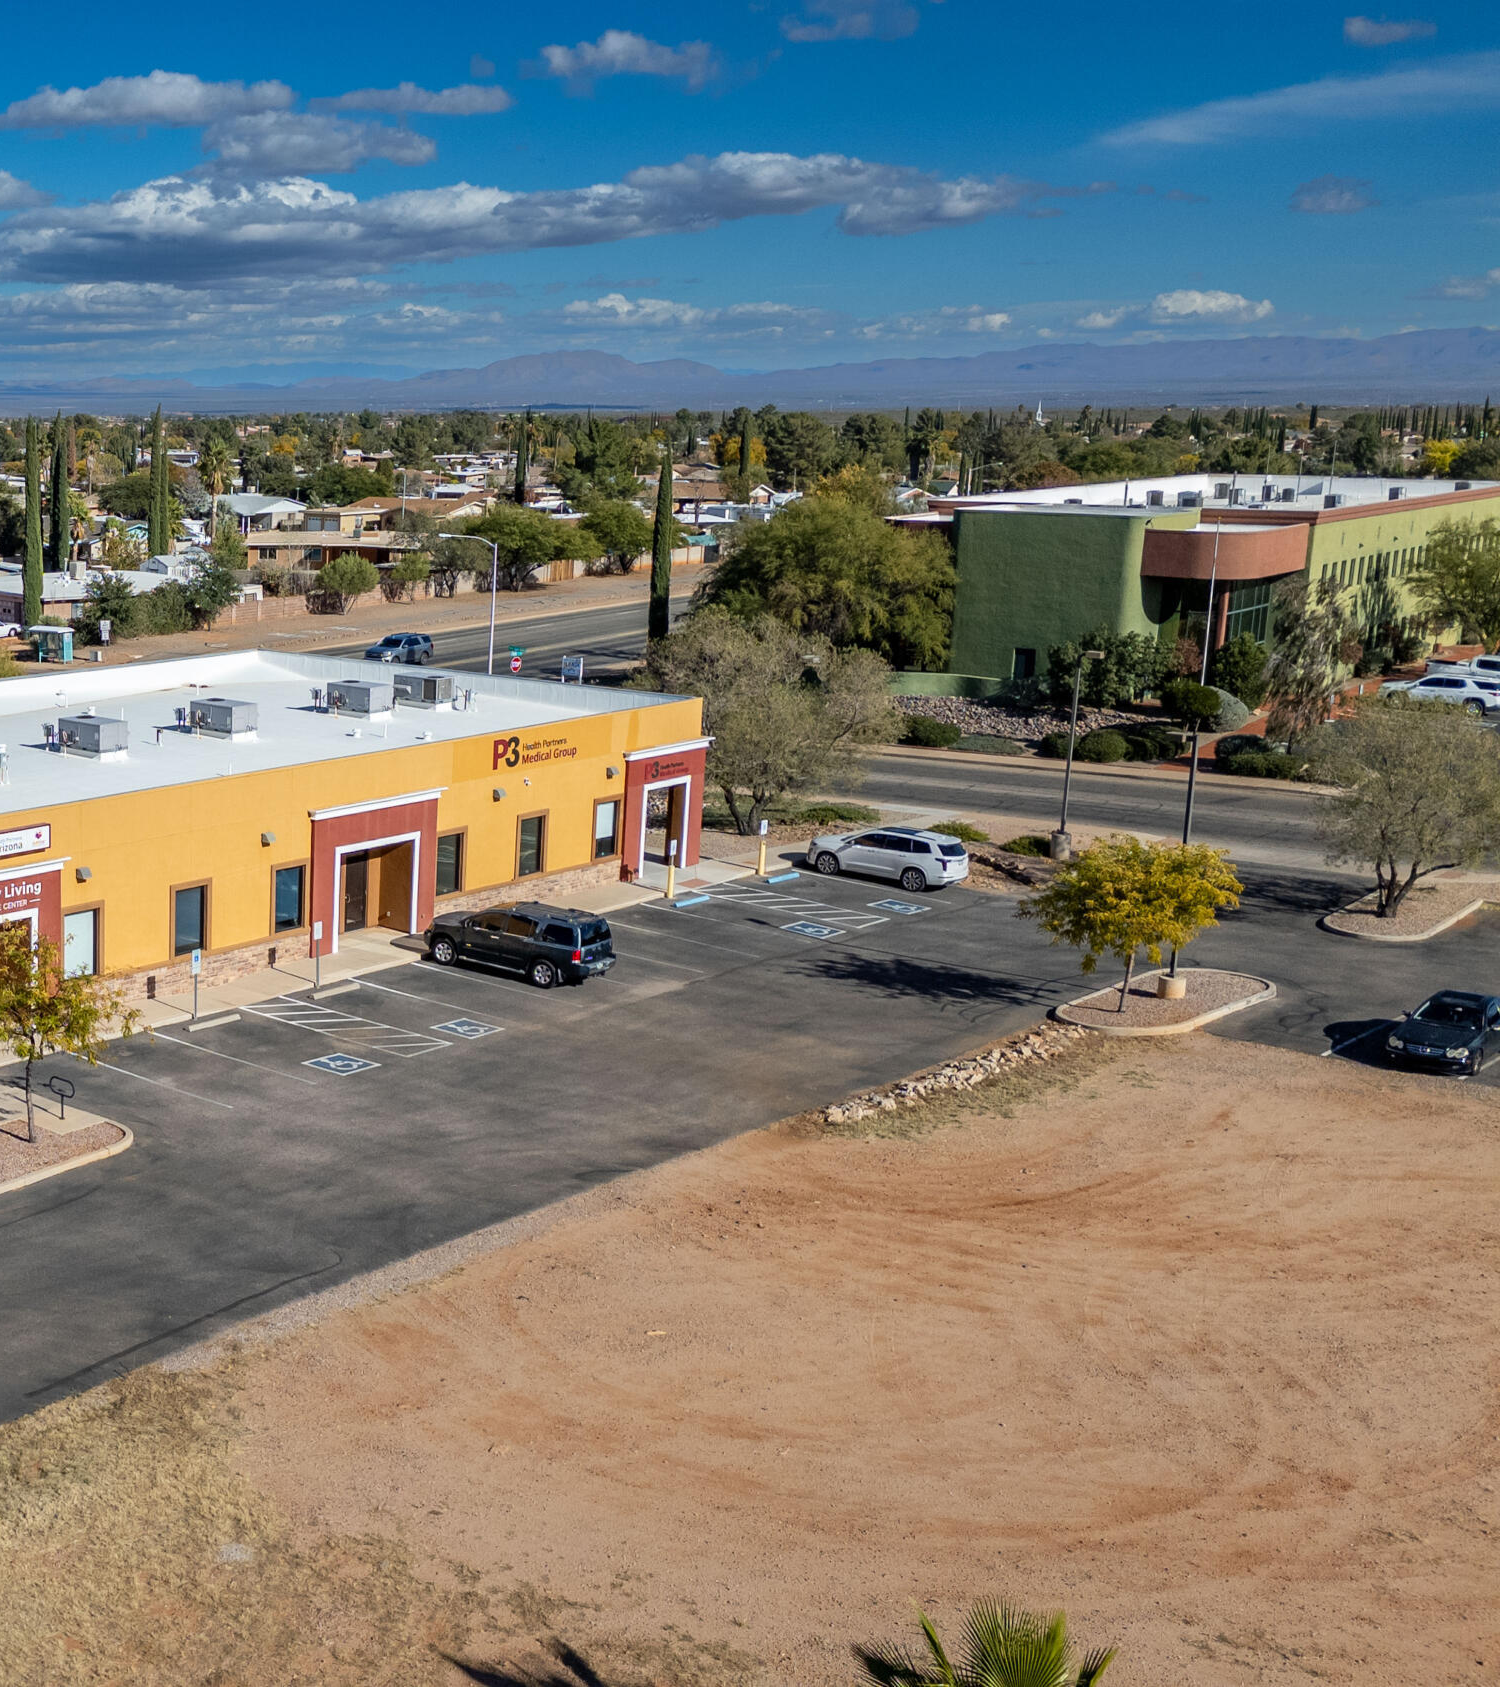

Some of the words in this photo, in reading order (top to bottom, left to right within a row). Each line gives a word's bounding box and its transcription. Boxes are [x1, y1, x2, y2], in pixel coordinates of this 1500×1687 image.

[492, 736, 520, 770] P3
[522, 740, 542, 752] Health
[521, 749, 552, 765] Medical
[553, 746, 577, 759] Group
[4, 881, 42, 898] Living
[2, 899, 28, 911] CENTER
